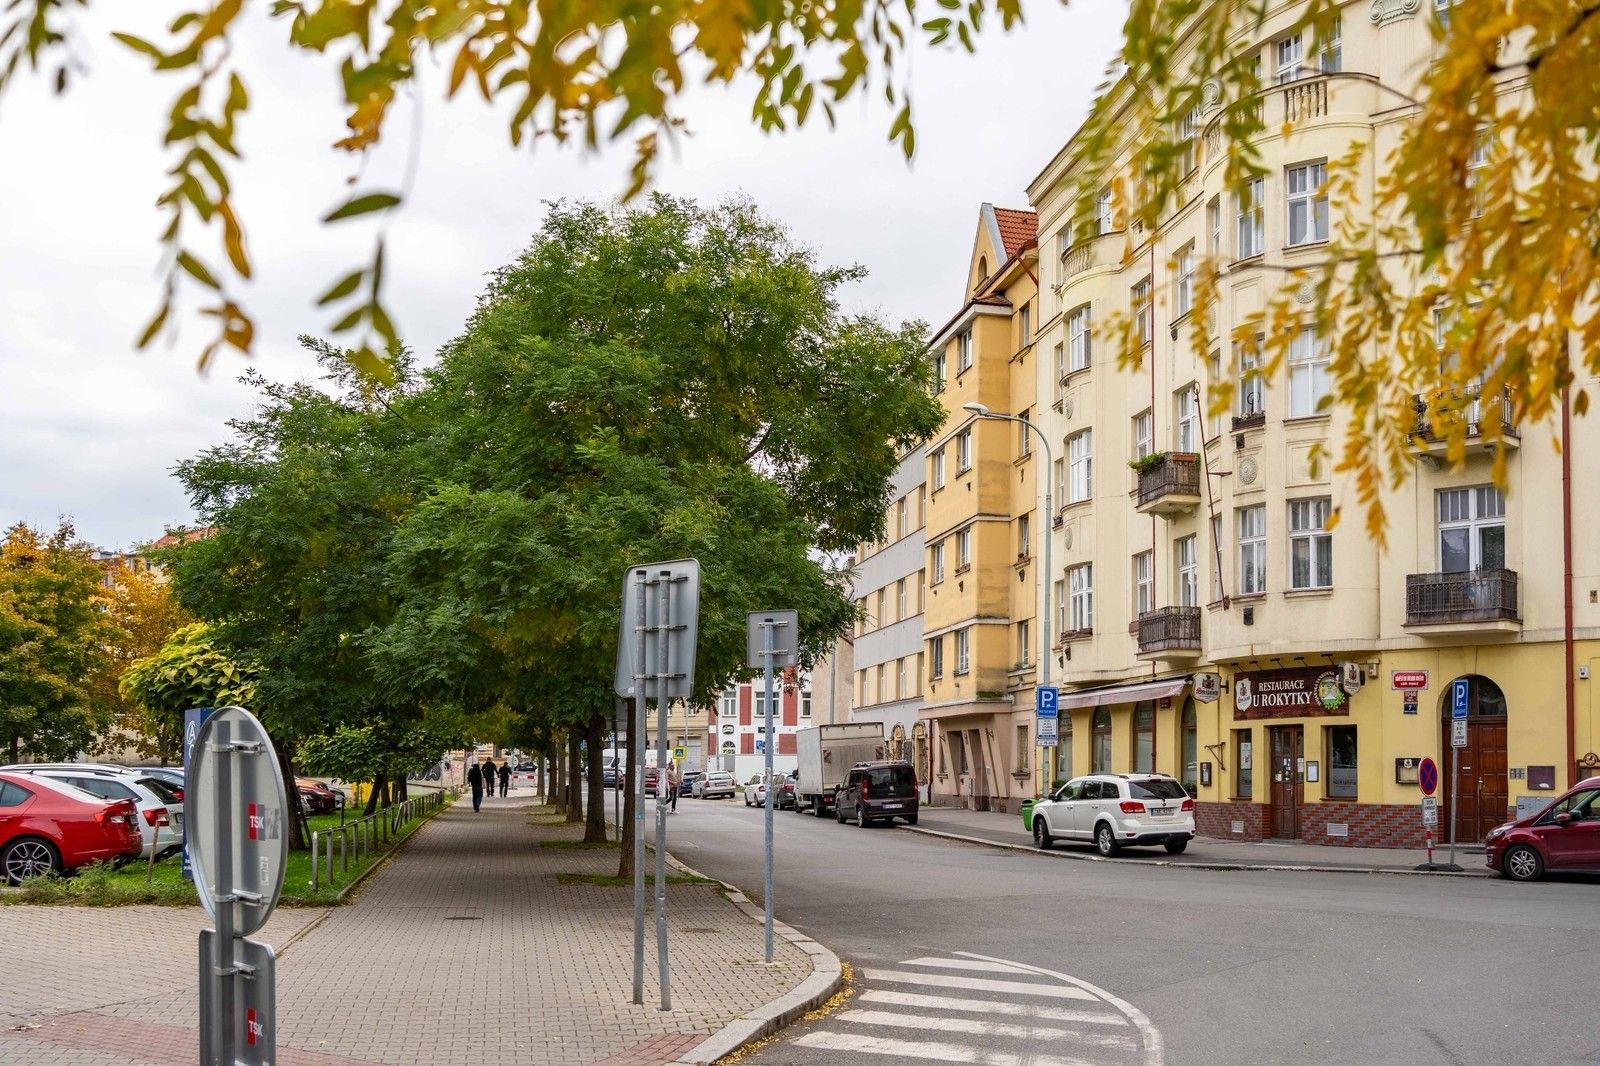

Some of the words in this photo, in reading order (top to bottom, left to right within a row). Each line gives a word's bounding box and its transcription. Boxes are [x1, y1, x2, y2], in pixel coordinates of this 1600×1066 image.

[1258, 680, 1304, 691] RESTAURACE
[1041, 690, 1053, 708] P
[1253, 694, 1260, 707] U
[1261, 691, 1312, 707] ROKYTKY
[1456, 685, 1465, 706] P
[249, 815, 264, 829] TSK
[249, 1020, 263, 1037] TSK
